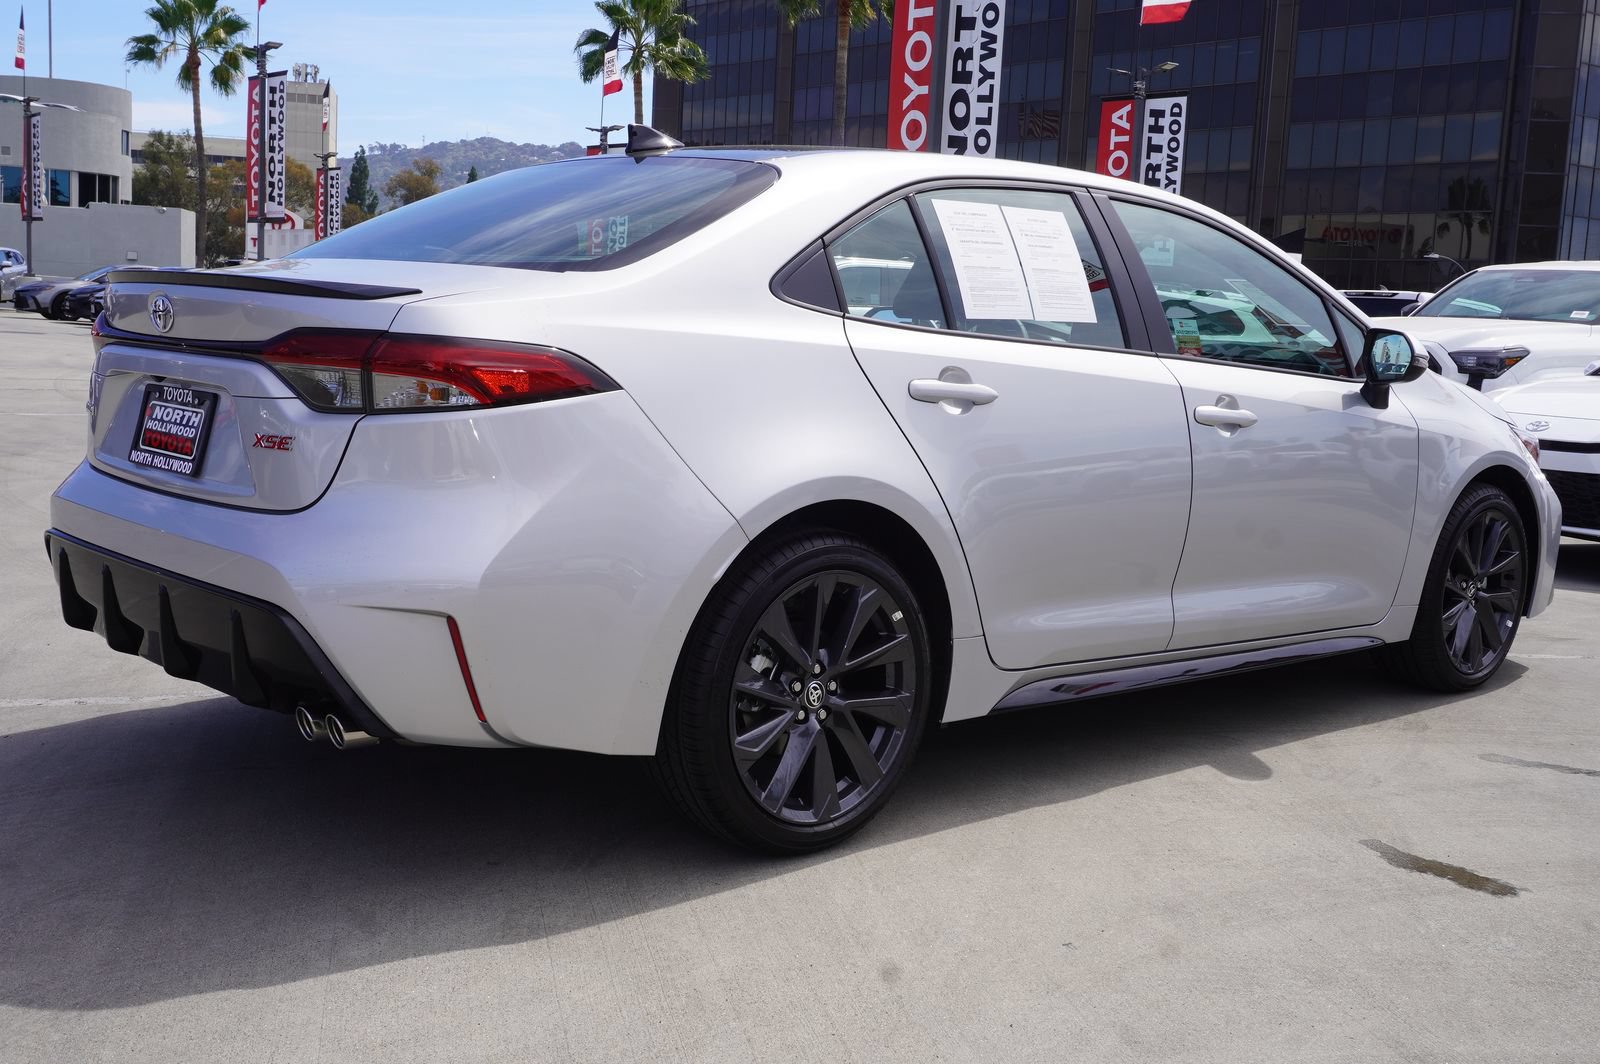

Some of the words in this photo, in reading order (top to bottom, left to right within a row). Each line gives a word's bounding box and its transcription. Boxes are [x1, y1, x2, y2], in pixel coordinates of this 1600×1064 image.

[251, 85, 260, 208] TOYOTA
[268, 86, 278, 203] NORTH
[277, 80, 285, 206] HOLLYWOOD
[163, 386, 193, 403] TOYOTA
[146, 419, 196, 438] HOLLYWOOD
[152, 406, 202, 427] NORTH
[143, 431, 193, 456] TOYOTA
[252, 432, 295, 452] XSE
[130, 450, 153, 466] NORTH
[152, 455, 193, 474] HOLLYWOOD
